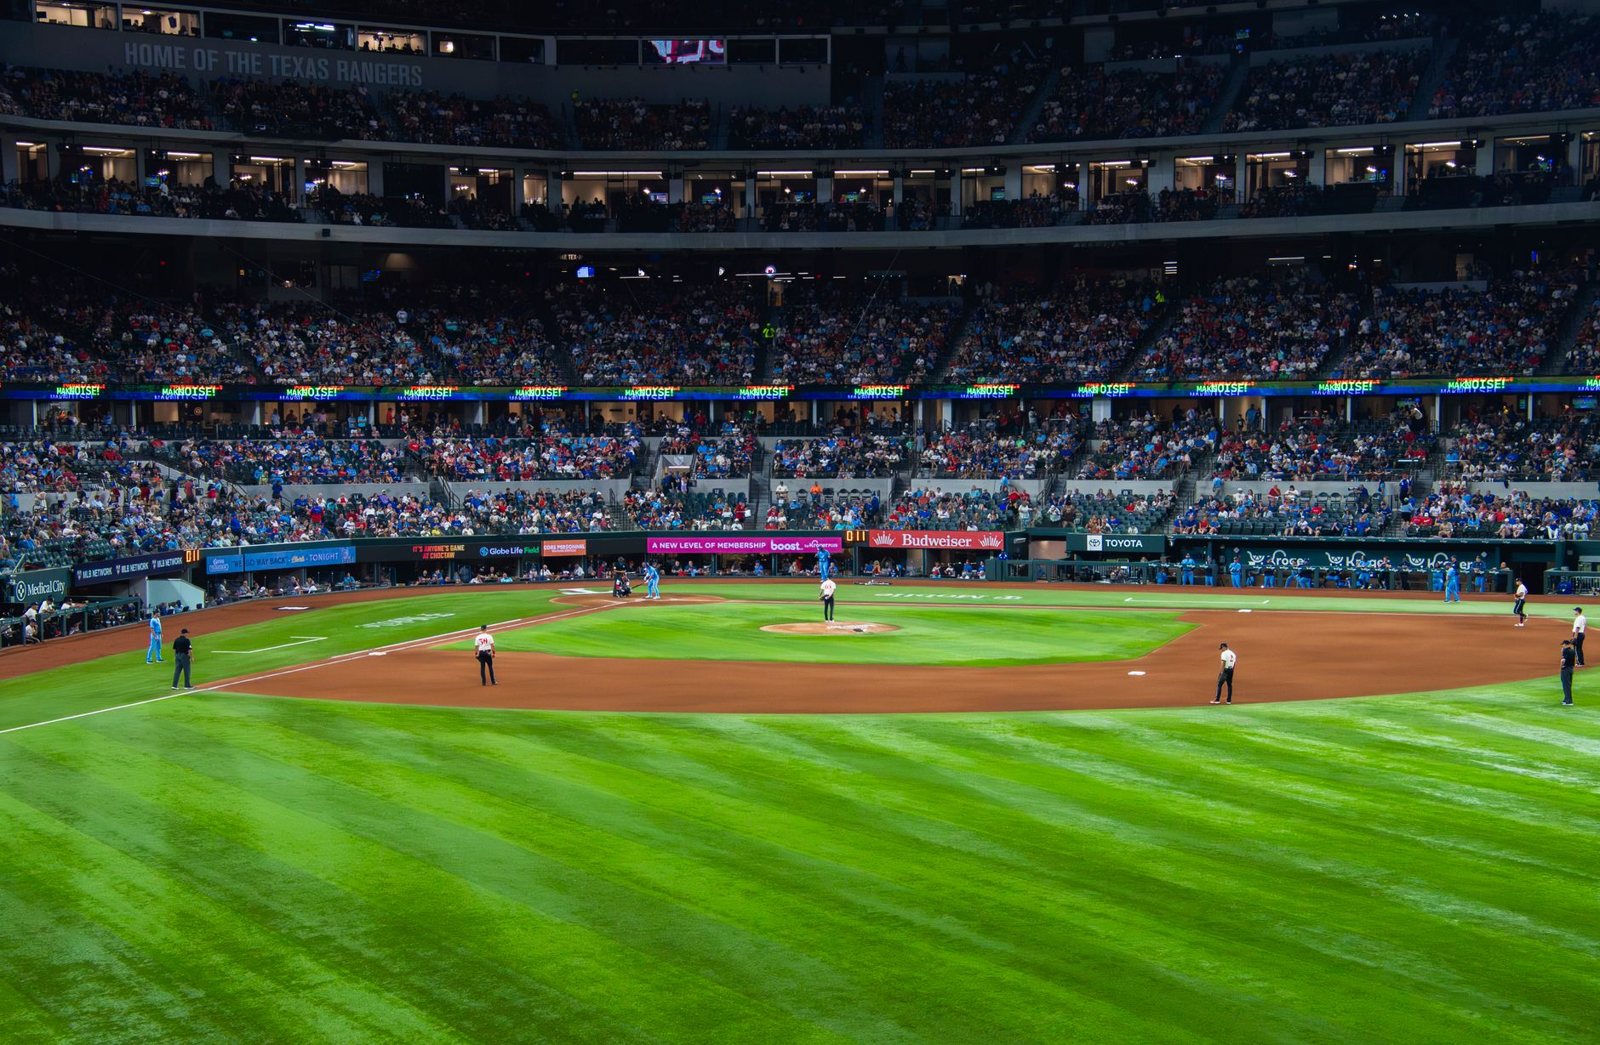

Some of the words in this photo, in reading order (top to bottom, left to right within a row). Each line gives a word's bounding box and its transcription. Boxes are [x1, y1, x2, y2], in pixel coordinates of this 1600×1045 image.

[124, 42, 186, 68] HOME
[194, 49, 218, 72] OF
[225, 51, 262, 75] THE
[269, 54, 328, 80] TEXAS
[337, 60, 422, 86] RANGERS
[902, 534, 972, 547] Budweiser
[1105, 539, 1142, 548] TOYOTA
[165, 557, 182, 567] NETWORK
[310, 552, 338, 562] TONIGHT
[130, 562, 148, 572] NETWORK
[83, 569, 92, 579] MLB
[92, 567, 112, 578] NETWORK
[28, 582, 52, 596] Medical
[53, 580, 65, 594] City
